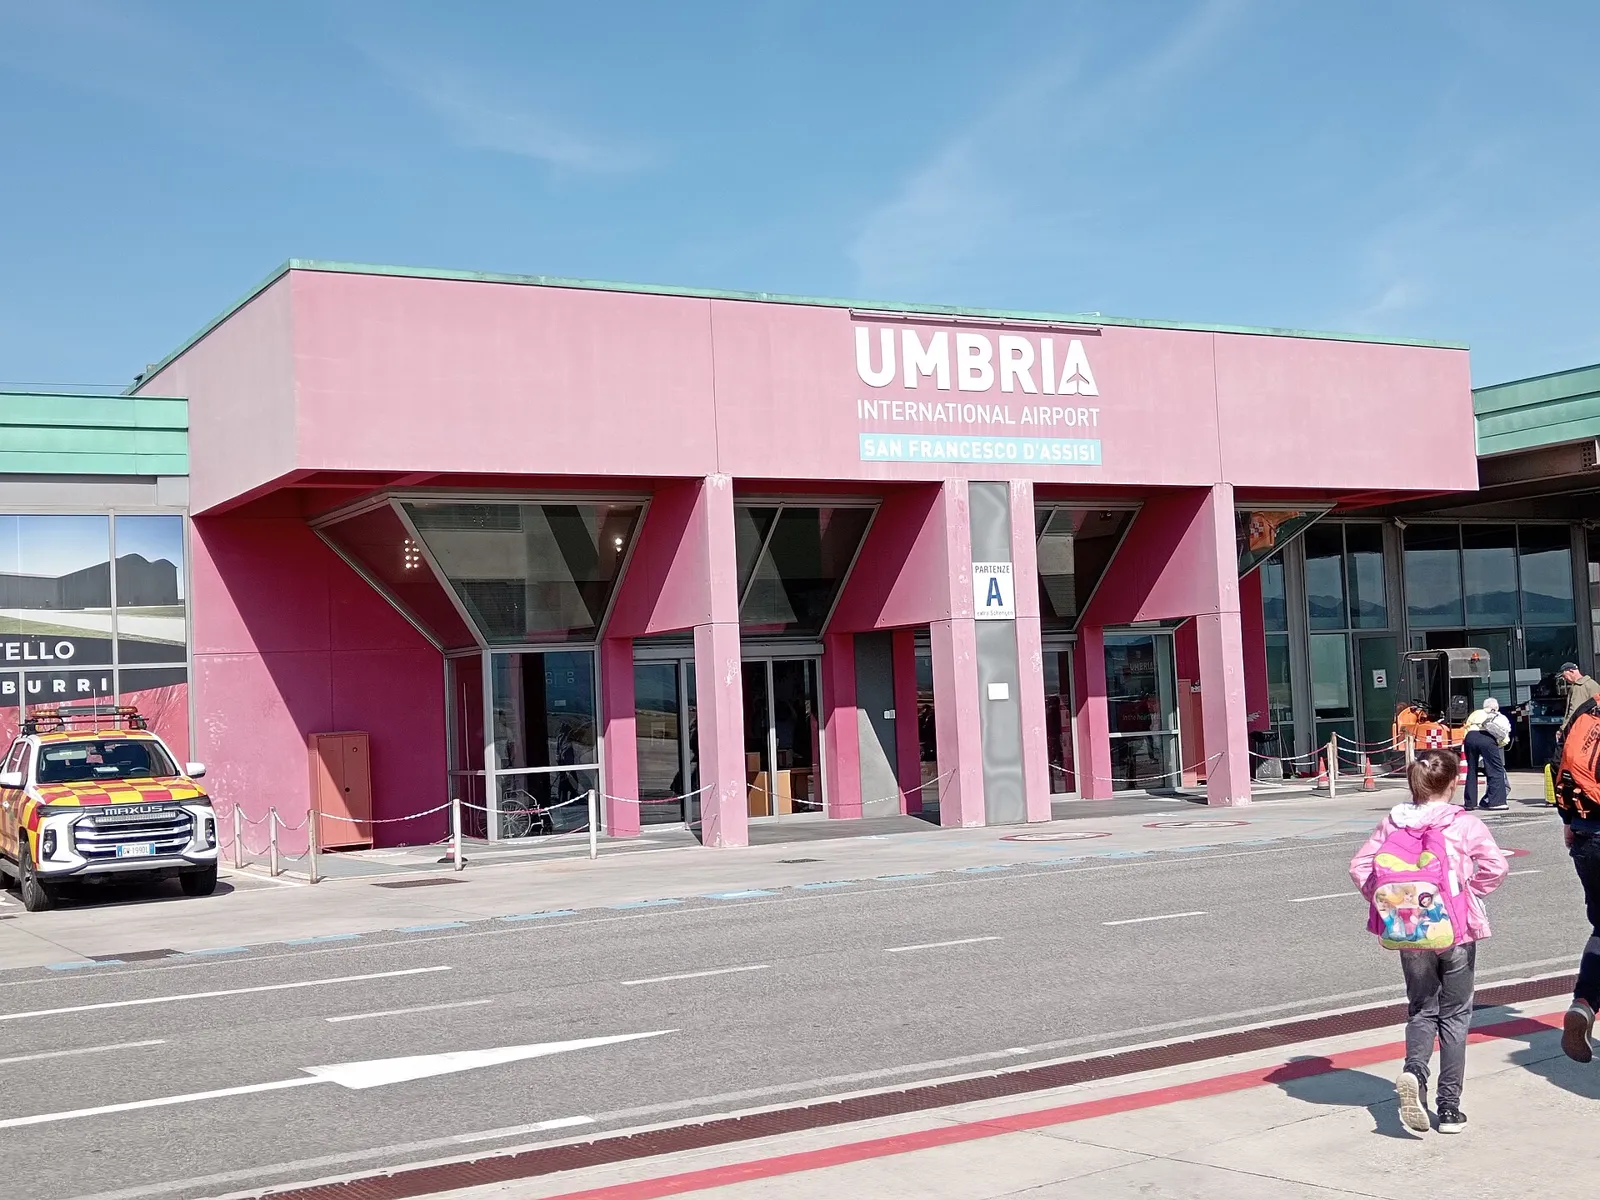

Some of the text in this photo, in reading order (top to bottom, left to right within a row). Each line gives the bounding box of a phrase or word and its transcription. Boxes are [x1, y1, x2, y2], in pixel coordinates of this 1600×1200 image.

[854, 326, 1099, 396] UMBRIA
[857, 399, 1099, 427] INTERNATIONAL AIRPORT
[864, 438, 1095, 461] SAN FRANCESCO D'ASSISI
[975, 565, 1010, 573] PARTENZE
[986, 577, 1003, 606] A
[0, 641, 74, 660] ELLO
[2, 678, 107, 694] BURRI
[105, 806, 163, 816] MAXUS
